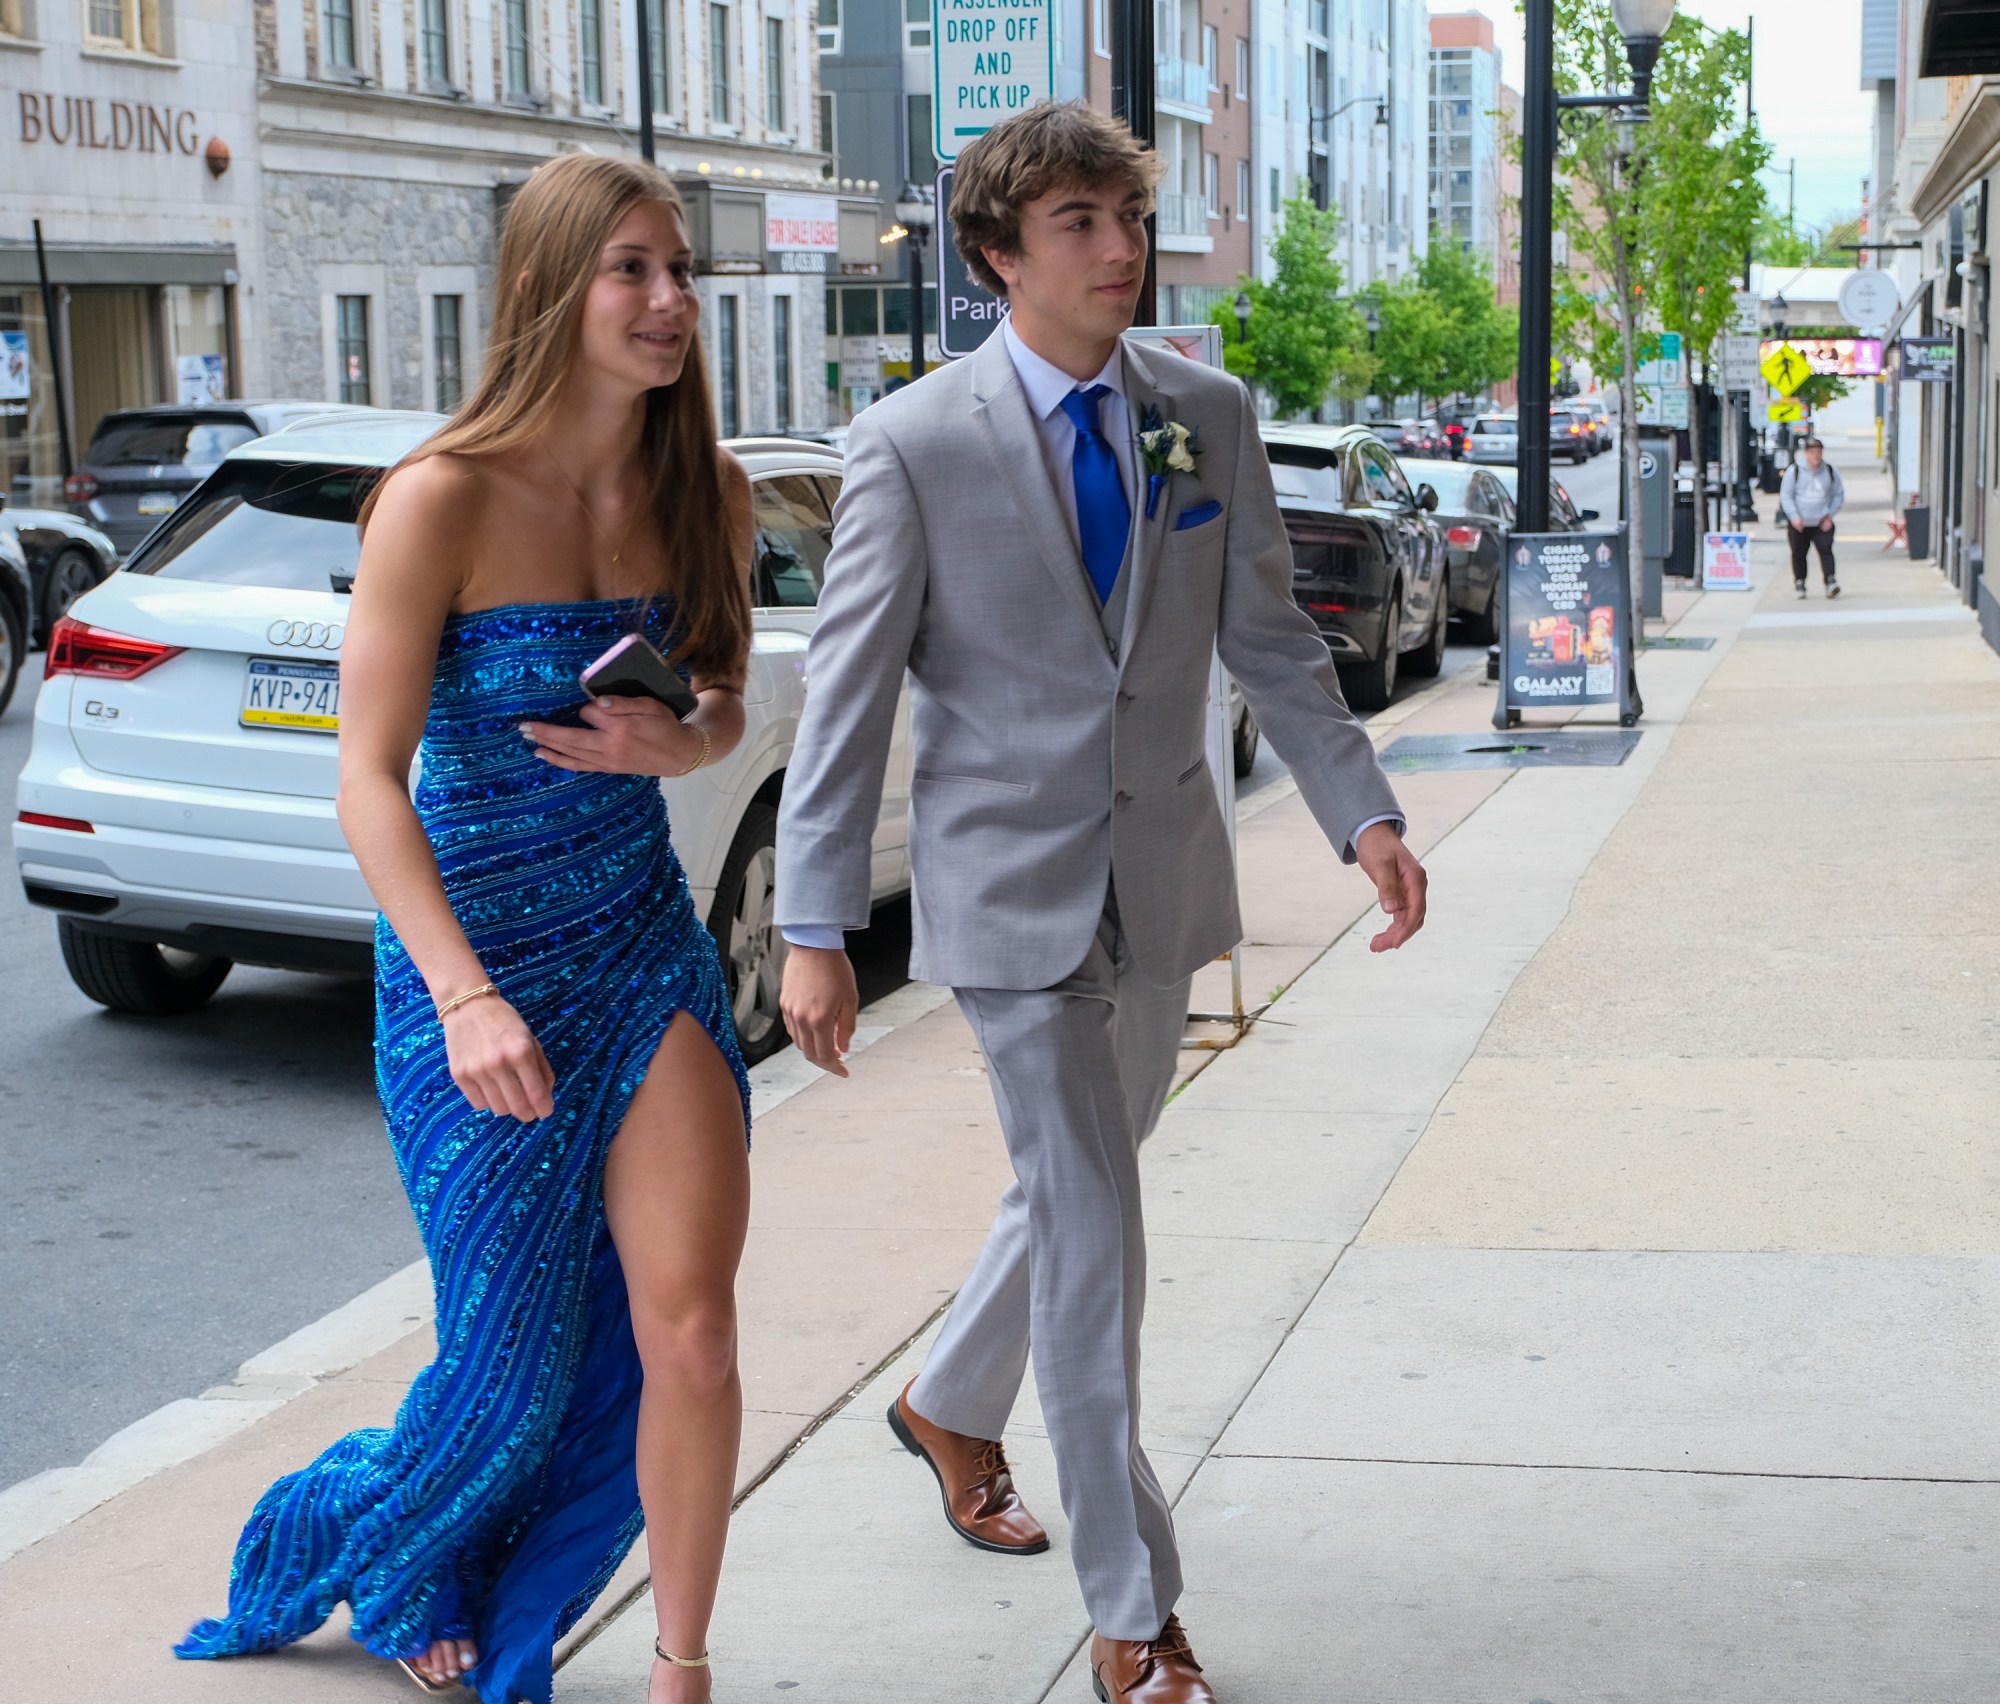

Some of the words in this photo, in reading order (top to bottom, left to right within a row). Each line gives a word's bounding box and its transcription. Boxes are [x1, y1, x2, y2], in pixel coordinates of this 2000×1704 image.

[948, 19, 996, 43] DROP
[1005, 17, 1039, 42] OFF
[974, 52, 1011, 75] AND
[958, 86, 1000, 109] PICK
[1006, 85, 1031, 109] UP
[19, 91, 199, 156] BUILDING
[768, 219, 784, 245] FOR
[1543, 544, 1584, 555] CIGARS
[1538, 554, 1590, 565] TOBACCO
[1546, 563, 1582, 573] VAPES
[1541, 581, 1588, 592] HOOKAH
[1546, 591, 1583, 601] GLASS
[1553, 600, 1576, 610] CBD
[1514, 675, 1584, 693] GALAXY
[85, 700, 119, 719] Q3
